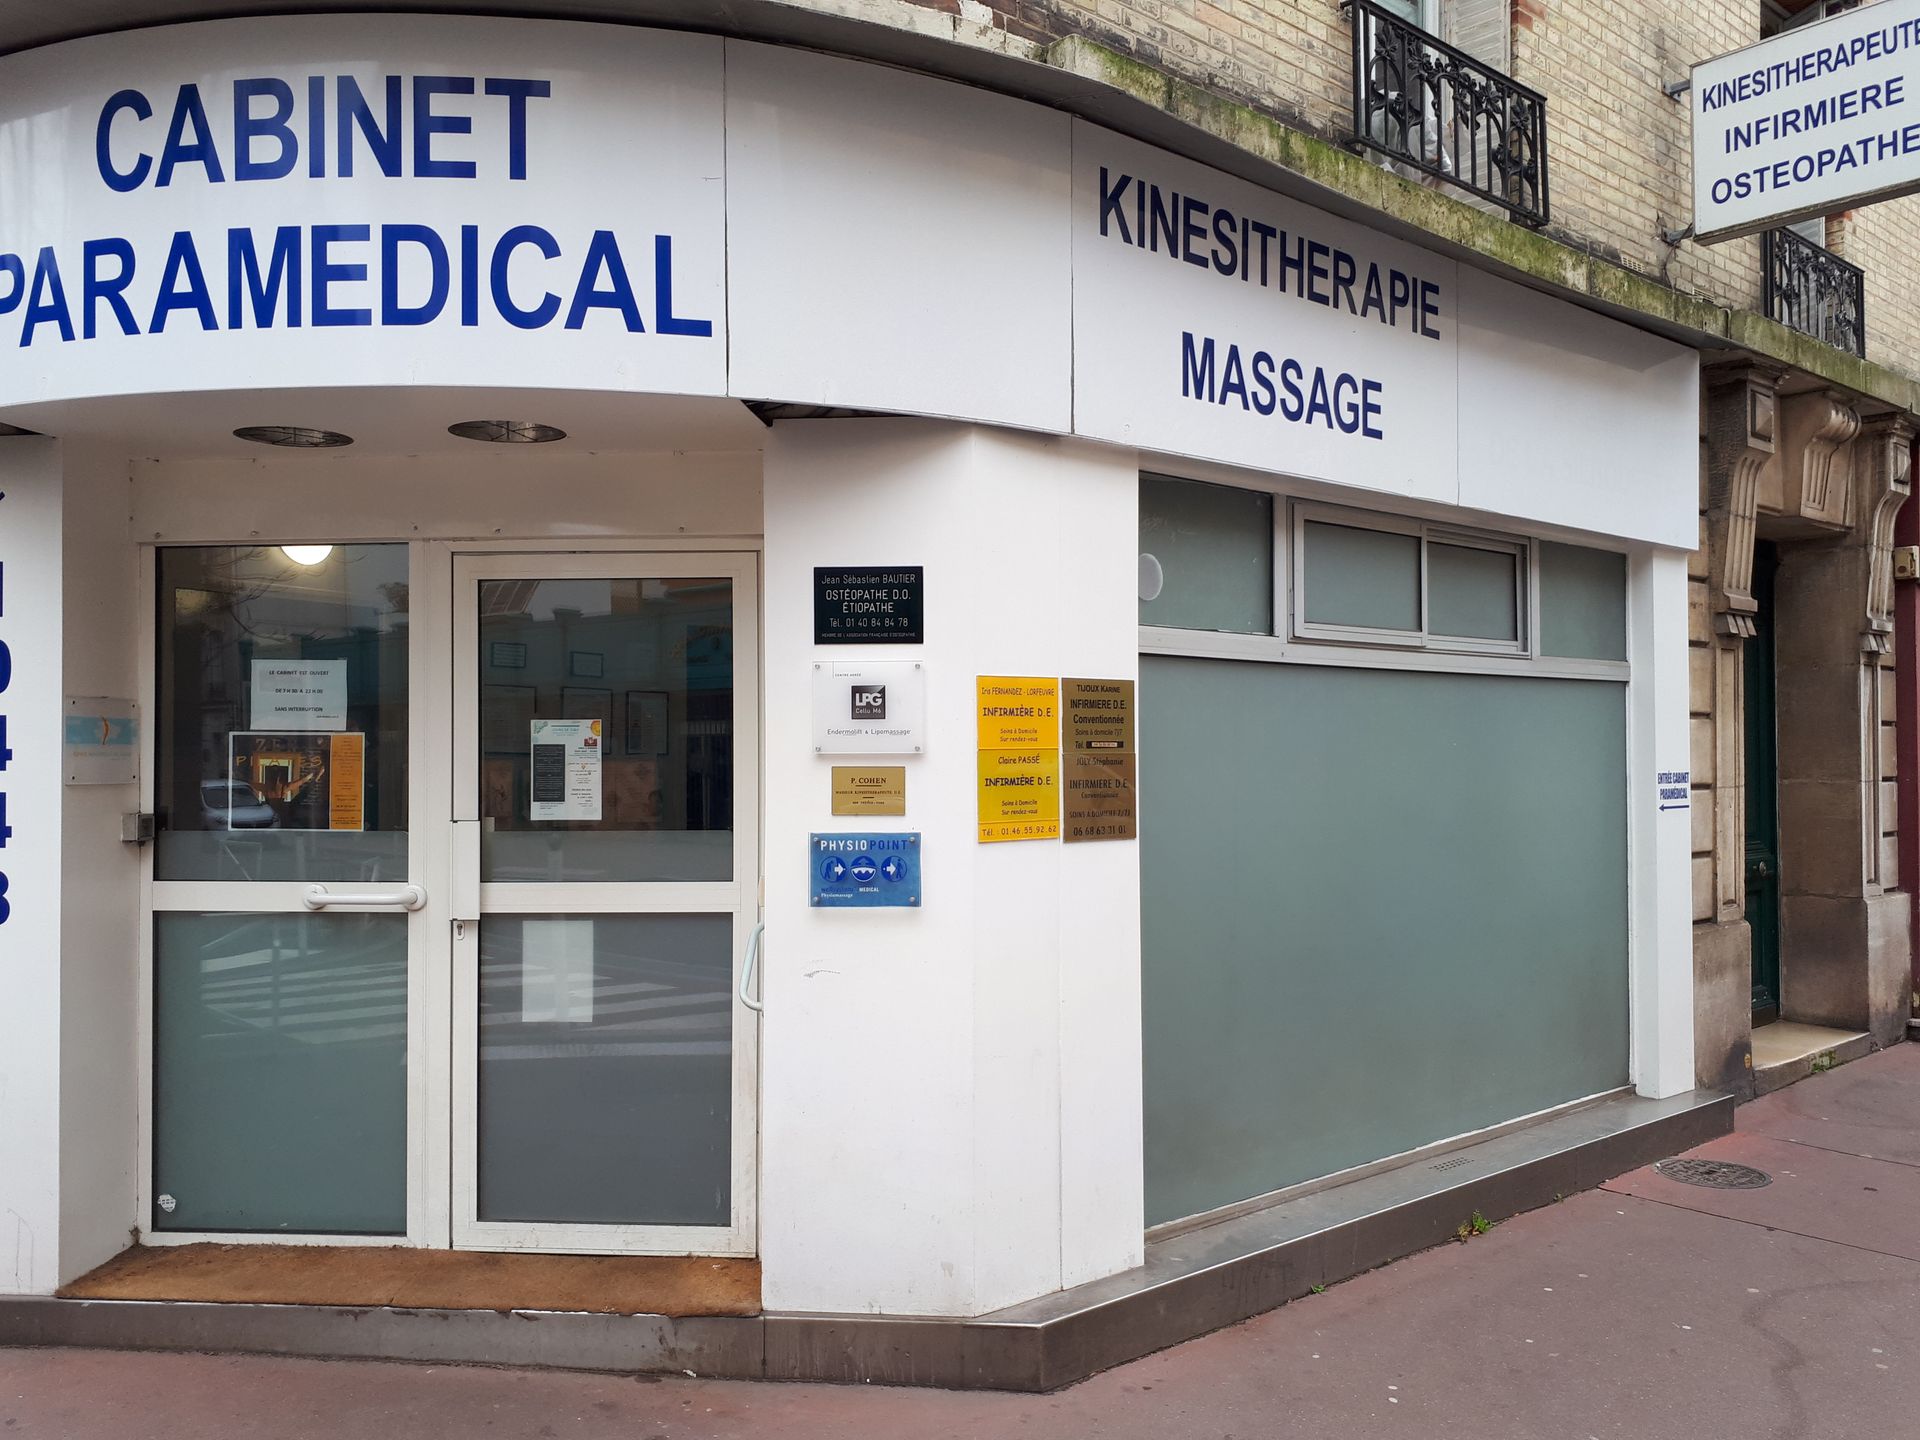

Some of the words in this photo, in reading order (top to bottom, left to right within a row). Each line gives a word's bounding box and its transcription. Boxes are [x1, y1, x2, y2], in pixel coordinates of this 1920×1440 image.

[1725, 75, 1905, 154] INFIRMIERE
[96, 75, 551, 193] CABINET
[1711, 123, 1920, 204] OSTEOPATHE
[1099, 166, 1440, 340] KINESITHERAPIE
[1182, 331, 1383, 440] MASSAGE
[822, 575, 840, 584] Jean
[843, 574, 880, 584] Sébastien
[882, 574, 916, 584] BAUTIER
[825, 588, 889, 600] OSTÉOPATHE
[892, 588, 911, 600] D.O.
[842, 601, 894, 613] ÉTIOPATHE
[846, 618, 855, 627] 01
[858, 618, 868, 627] 40
[871, 618, 881, 627] 84
[884, 618, 895, 627] 84
[898, 618, 909, 627] 78
[856, 692, 882, 706] LPG
[1113, 700, 1127, 710] D.E.
[983, 704, 1034, 717] INFIRMIÈRE
[1038, 708, 1054, 718] D.E.
[998, 756, 1017, 764] Claire
[1018, 753, 1040, 764] PASSÉ
[984, 774, 1034, 787] INFIRMIÈRE
[1074, 826, 1082, 836] 06
[1085, 826, 1094, 836] 68
[1096, 826, 1105, 835] 63
